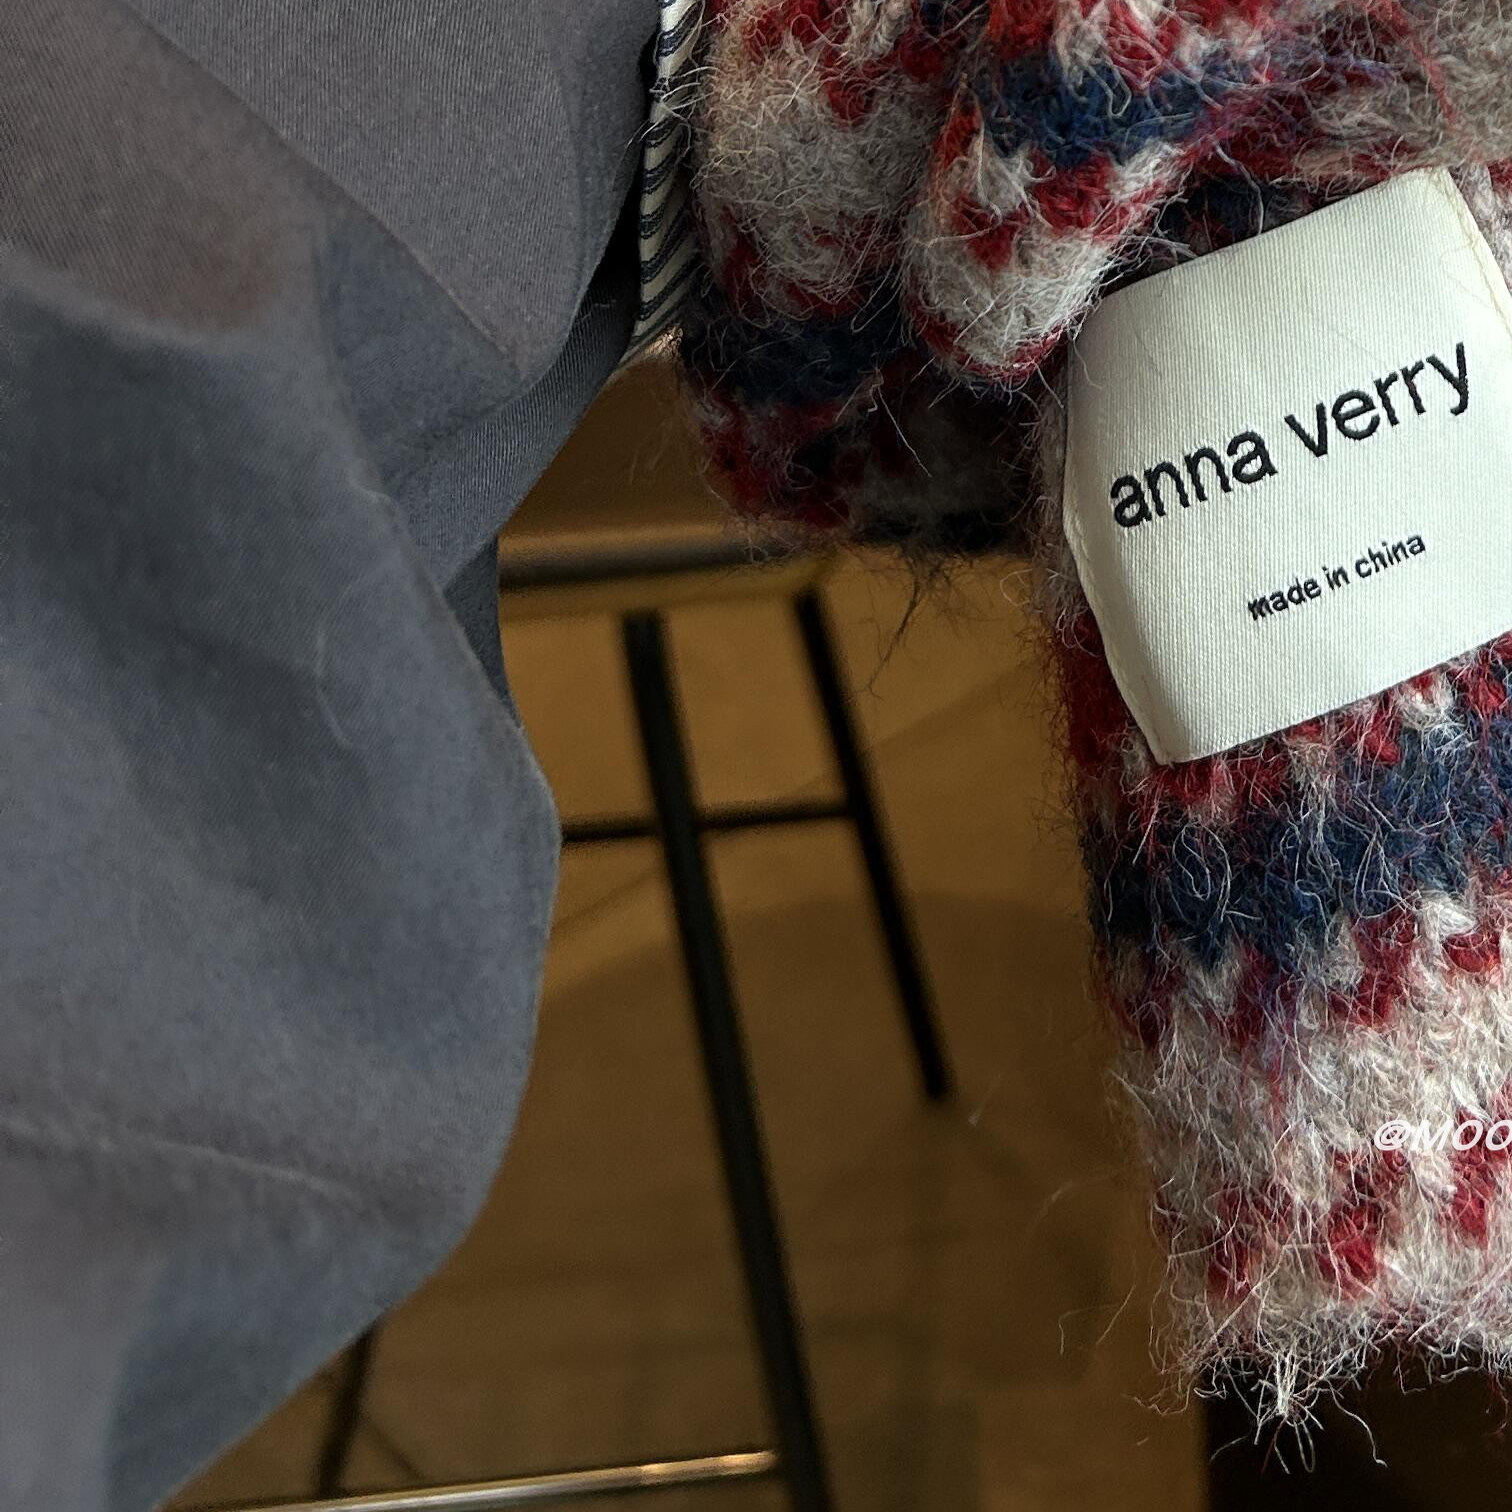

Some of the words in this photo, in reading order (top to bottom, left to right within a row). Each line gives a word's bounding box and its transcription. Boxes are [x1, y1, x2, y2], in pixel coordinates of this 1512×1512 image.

[1109, 430, 1278, 529] anna
[1284, 342, 1470, 458] verry
[1247, 577, 1322, 621] made
[1322, 565, 1351, 591] in
[1355, 533, 1427, 579] china
